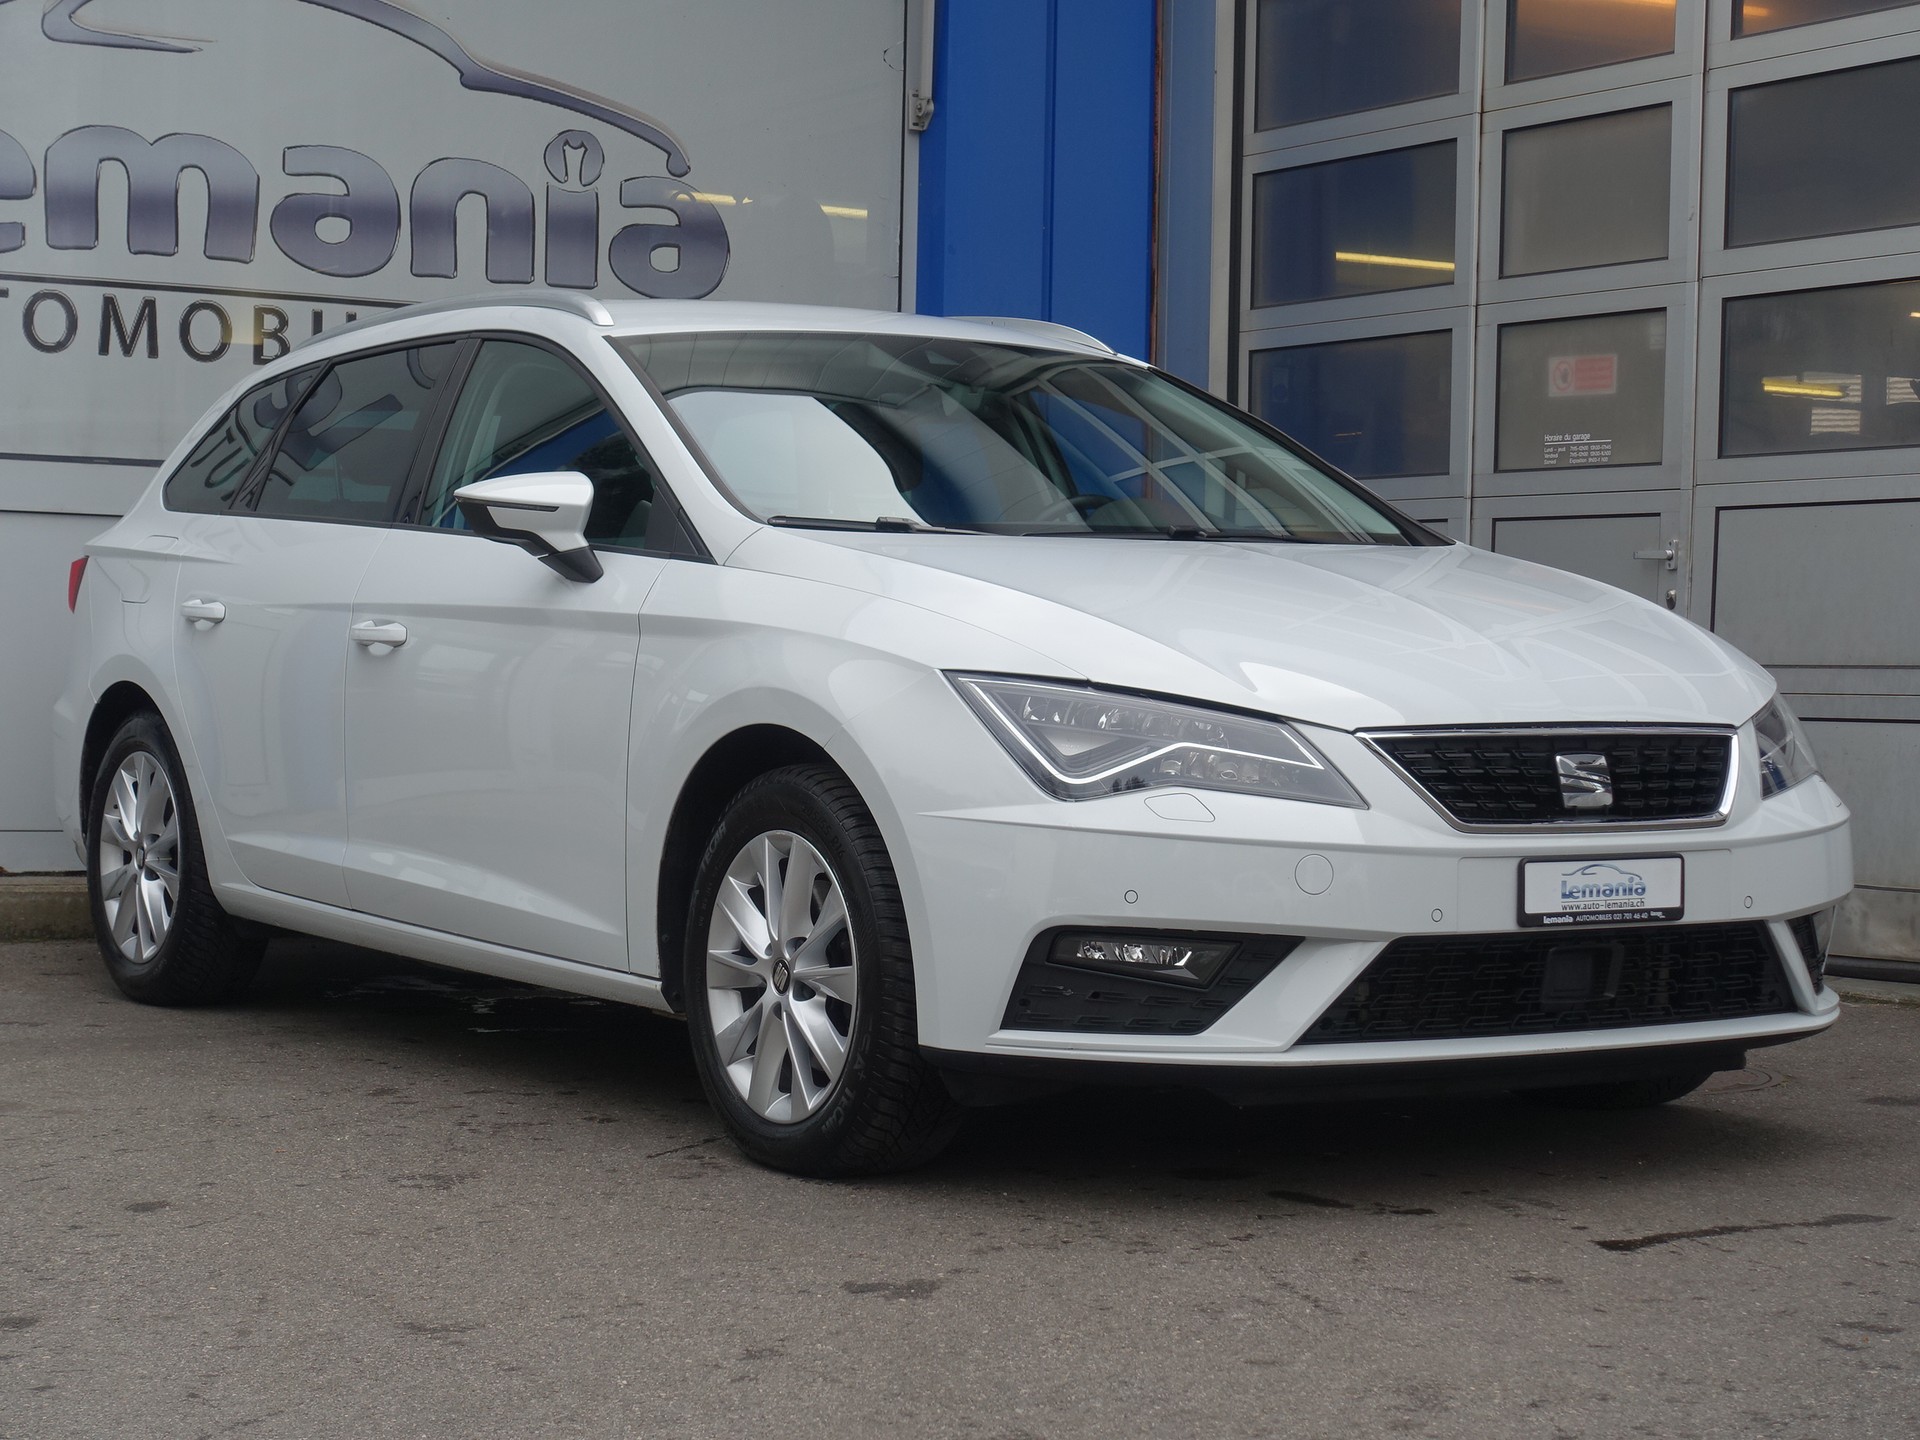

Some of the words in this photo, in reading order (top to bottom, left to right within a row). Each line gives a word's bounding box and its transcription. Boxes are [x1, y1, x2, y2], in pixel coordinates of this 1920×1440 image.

[1573, 433, 1590, 442] garage
[1561, 899, 1645, 911] www.auto-lemania.ch
[1576, 913, 1612, 921] AUTOMOBILES
